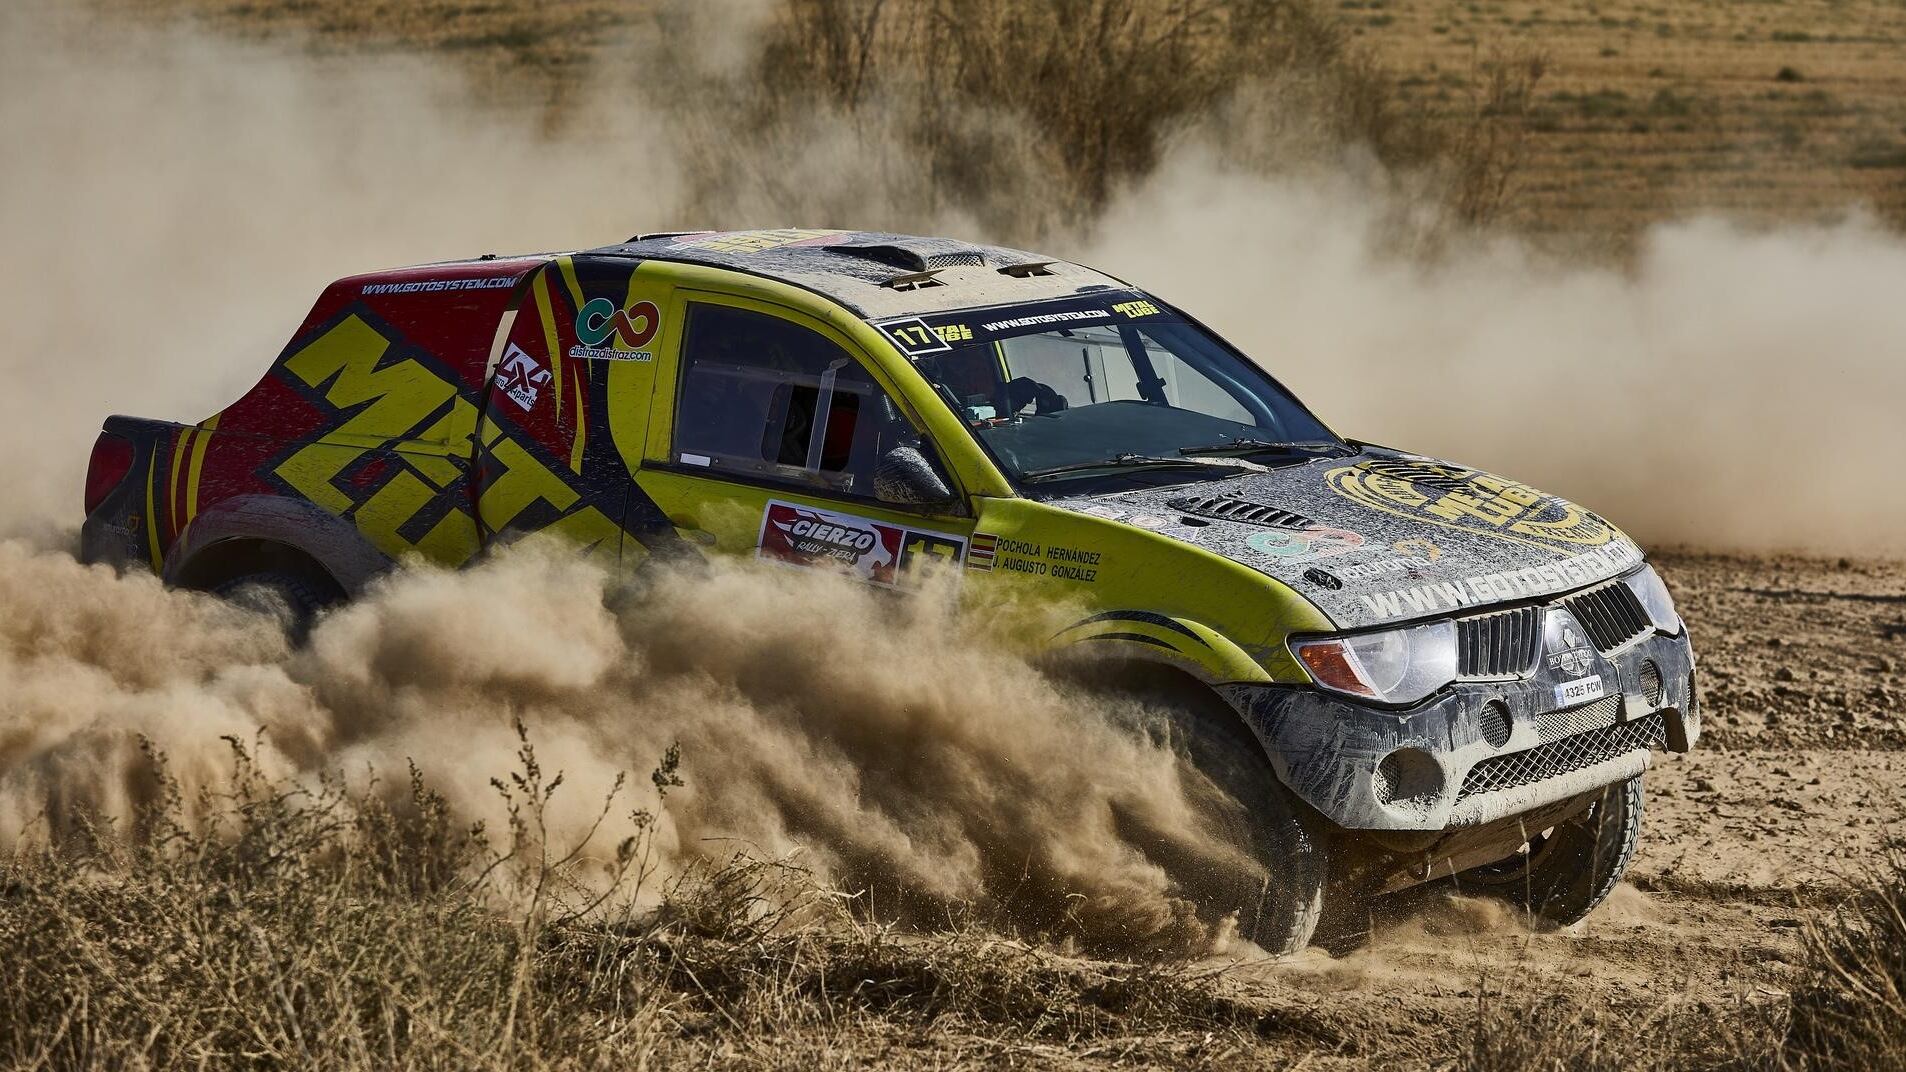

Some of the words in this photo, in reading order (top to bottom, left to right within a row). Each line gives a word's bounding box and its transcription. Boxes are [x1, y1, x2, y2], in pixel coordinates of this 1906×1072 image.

[361, 277, 518, 295] WWW.GOTOSYSTEM.COM
[1111, 300, 1153, 313] METAL
[1123, 307, 1160, 318] LUBE
[982, 310, 1110, 331] WWW.GOTOSYSTEM.COM
[893, 326, 931, 346] 17
[570, 345, 652, 361] disfrazdisfraz.com
[792, 520, 875, 550] CIERZO
[797, 541, 824, 555] RALLY
[997, 538, 1041, 557] POCHOLA
[1047, 545, 1102, 565] HERNÁNDEZ
[907, 540, 956, 585] 17
[1003, 558, 1047, 575] AUGUSTO
[1052, 565, 1097, 582] GONZÁLEZ
[1586, 680, 1601, 694] FCW
